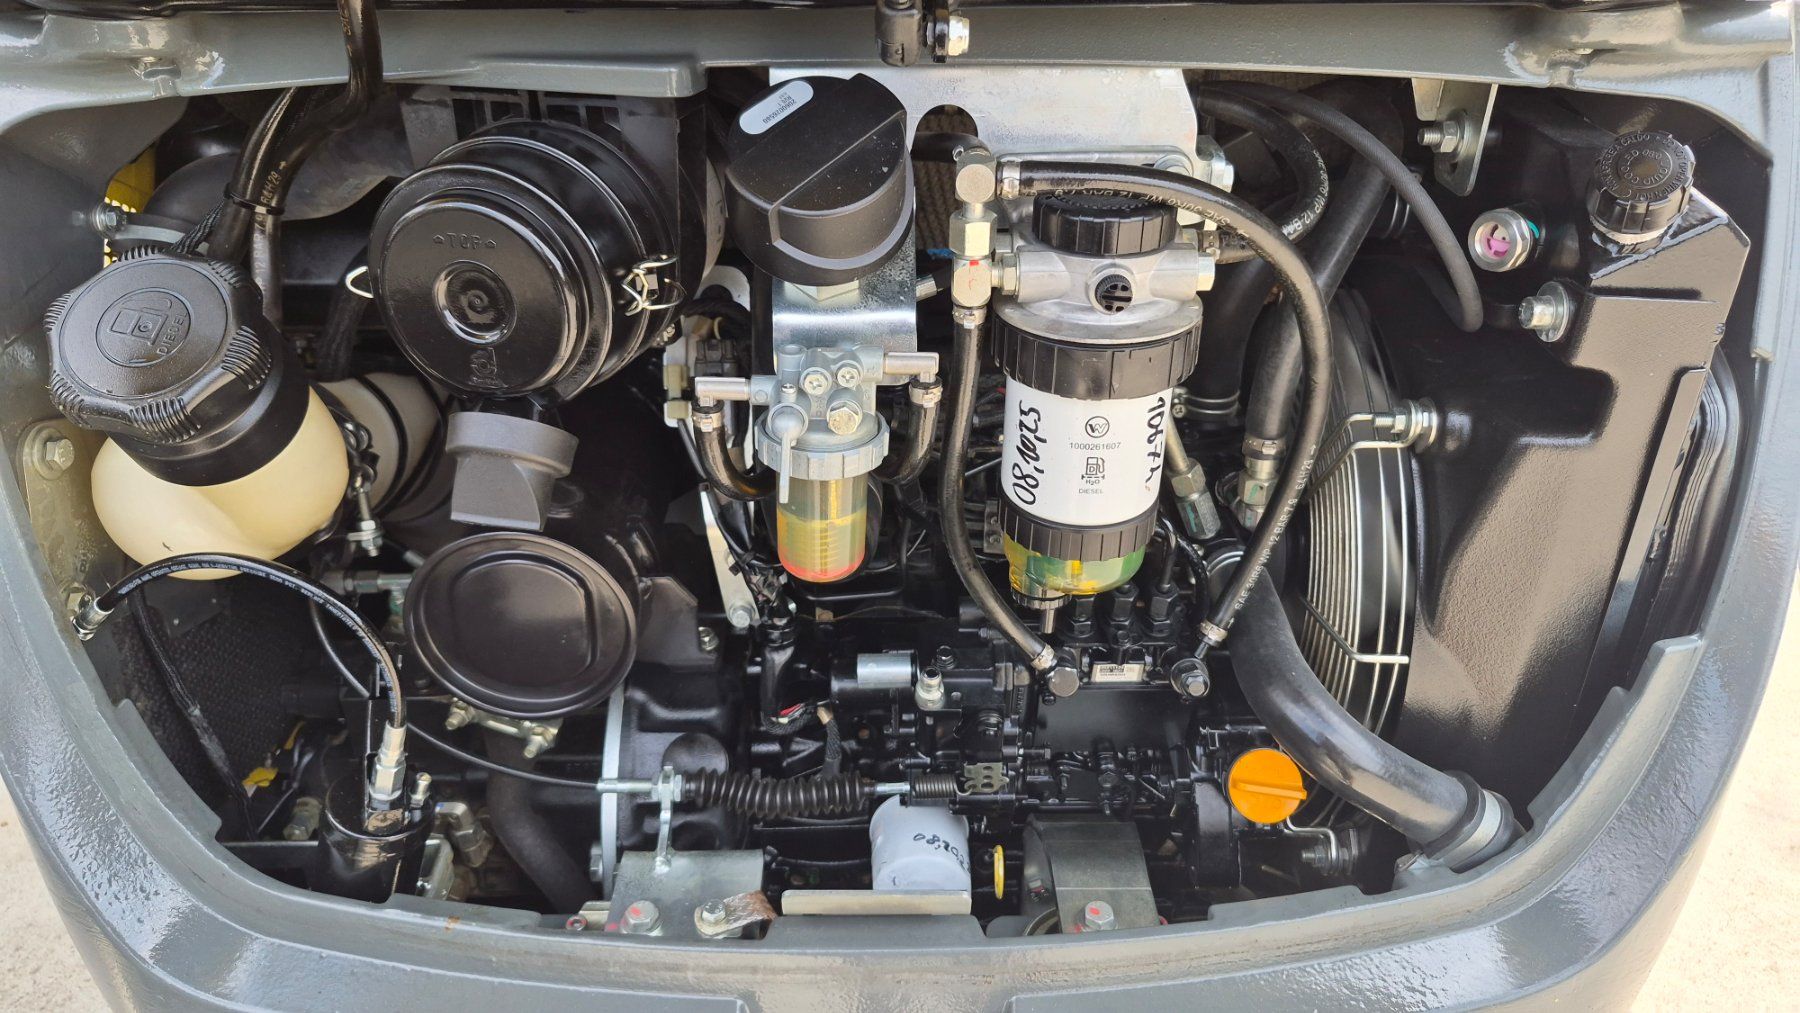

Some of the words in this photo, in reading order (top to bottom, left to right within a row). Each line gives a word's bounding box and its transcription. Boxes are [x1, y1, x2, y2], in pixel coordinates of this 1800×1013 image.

[156, 312, 188, 356] DIESEL
[1069, 441, 1122, 451] 1000261607
[1234, 589, 1251, 611] SAE
[1246, 565, 1264, 591] 30R6
[1258, 548, 1272, 567] WP
[1273, 510, 1293, 535] BAR
